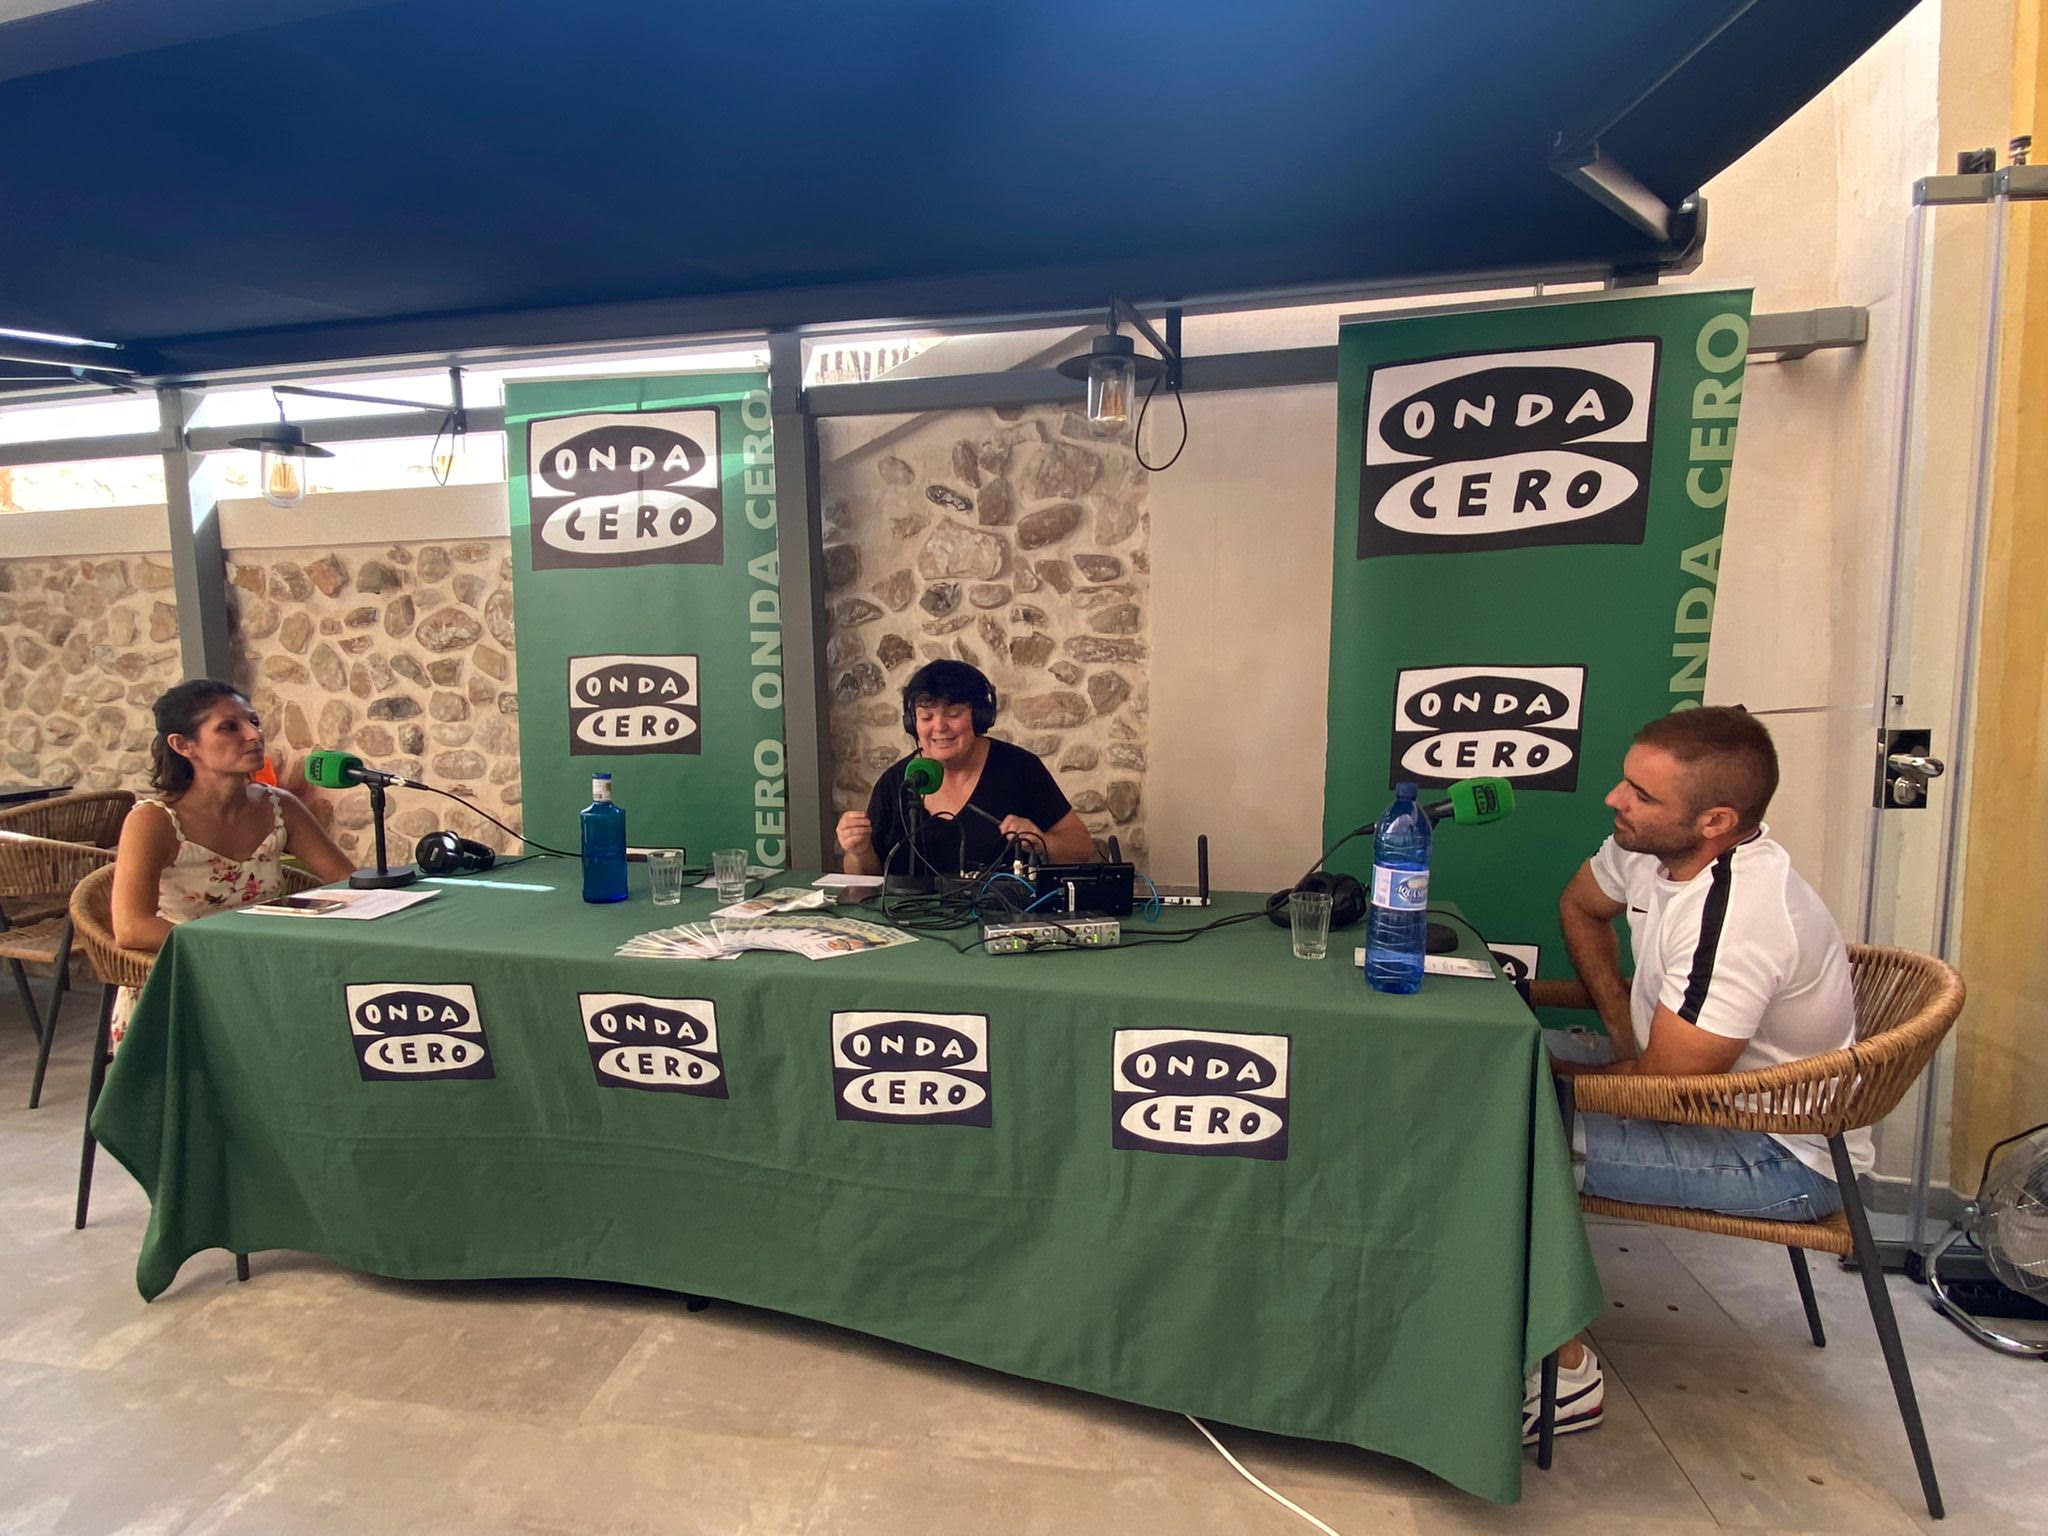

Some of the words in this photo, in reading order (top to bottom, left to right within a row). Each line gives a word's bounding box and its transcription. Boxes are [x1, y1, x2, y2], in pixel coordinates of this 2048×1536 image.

[1403, 388, 1605, 439] ONDA
[1686, 312, 1749, 509] CERO
[555, 444, 692, 480] ONDA
[741, 389, 778, 530] CERO
[1409, 469, 1602, 519] CERO
[565, 504, 692, 541] CERO
[748, 556, 783, 708] ONDA
[586, 675, 679, 696] ONDA
[1419, 691, 1552, 717] ONDA
[592, 714, 680, 738] CERO
[1424, 740, 1550, 768] CERO
[753, 738, 787, 868] CERO
[365, 1003, 460, 1024] ONDA
[601, 1012, 697, 1041] ONDA
[379, 1042, 467, 1064] CERO
[852, 1033, 965, 1059] ONDA
[616, 1051, 703, 1079] CERO
[1135, 1053, 1262, 1083] ONDA
[861, 1078, 967, 1105] CERO
[1142, 1103, 1261, 1136] CERO
